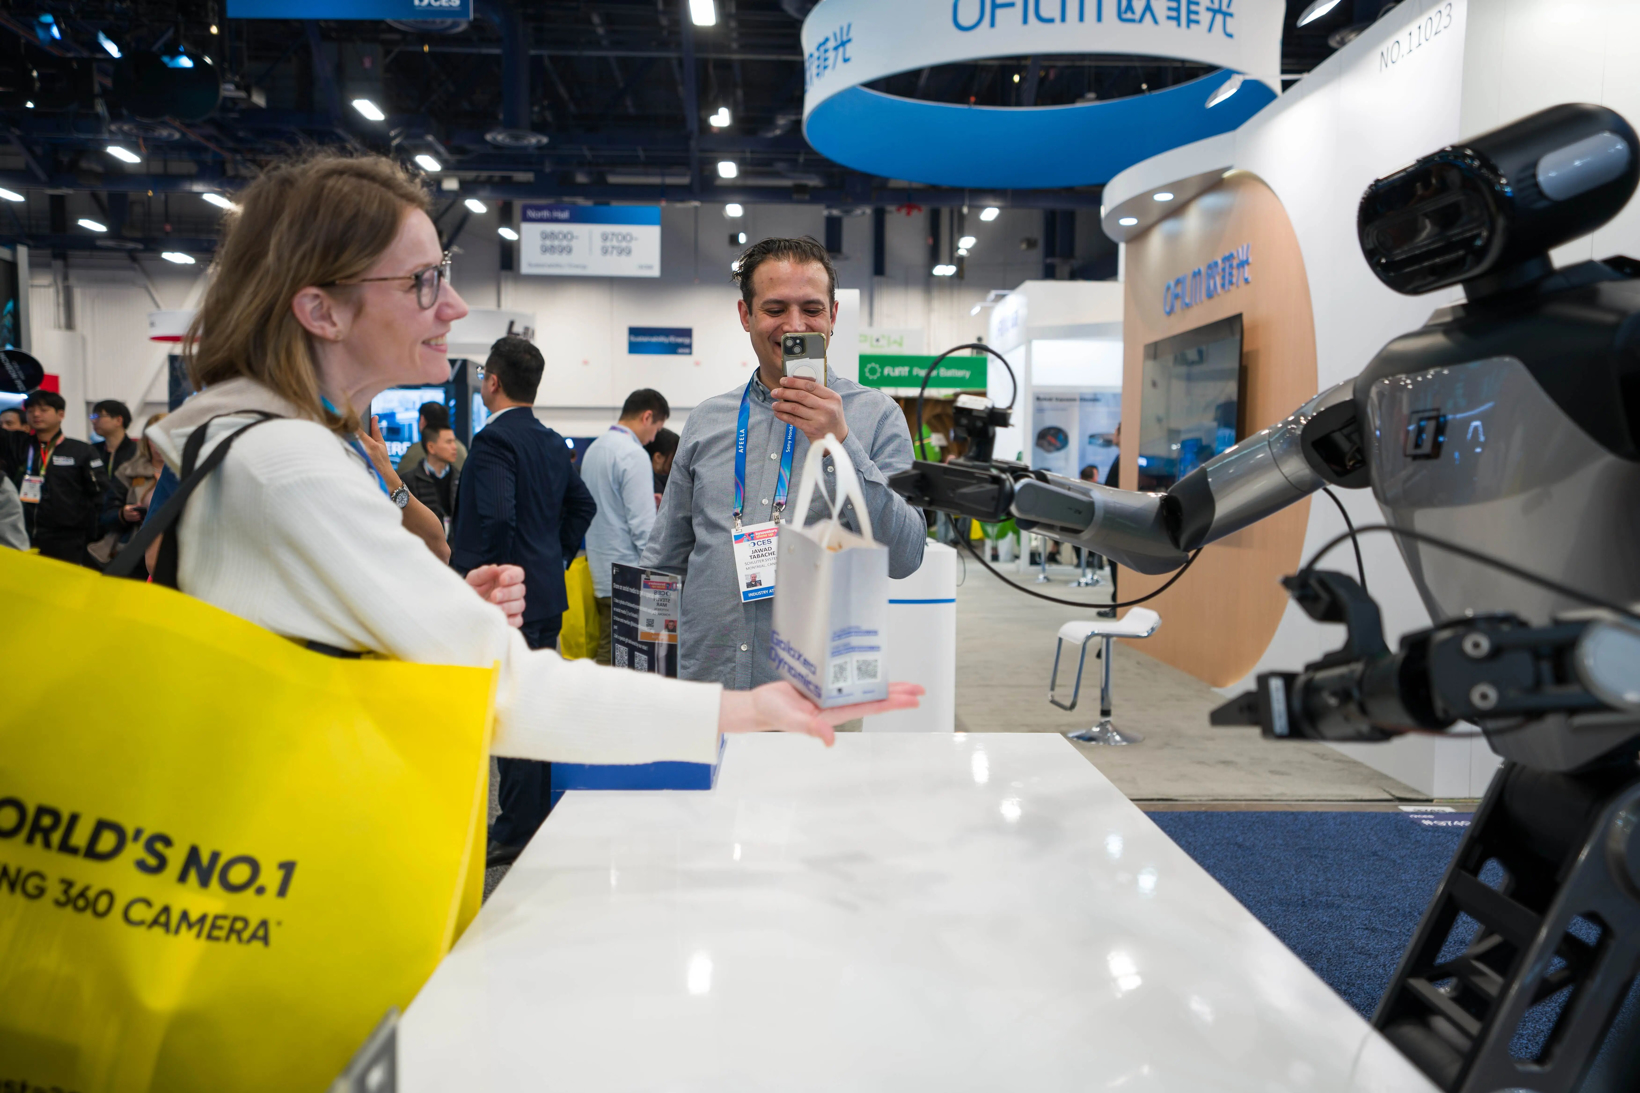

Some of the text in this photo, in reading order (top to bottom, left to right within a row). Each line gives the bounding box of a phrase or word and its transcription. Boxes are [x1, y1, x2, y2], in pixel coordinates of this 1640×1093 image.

[1380, 2, 1452, 72] NO.11023
[526, 208, 570, 220] North Hall
[540, 230, 579, 242] 9800-
[601, 231, 638, 244] 9700-
[540, 243, 573, 256] 9899
[601, 244, 632, 257] 9799
[1205, 243, 1251, 300] 欧菲光
[1164, 268, 1203, 316] OFILM
[884, 366, 971, 380] FLINT Papr Battery
[756, 538, 772, 546] CES
[752, 546, 772, 554] JAWAD
[770, 630, 816, 676] Galaxea
[769, 646, 822, 699] Dynamics
[176, 844, 298, 898] NO.1
[53, 878, 116, 918] 360
[122, 897, 270, 948] CAMERA
